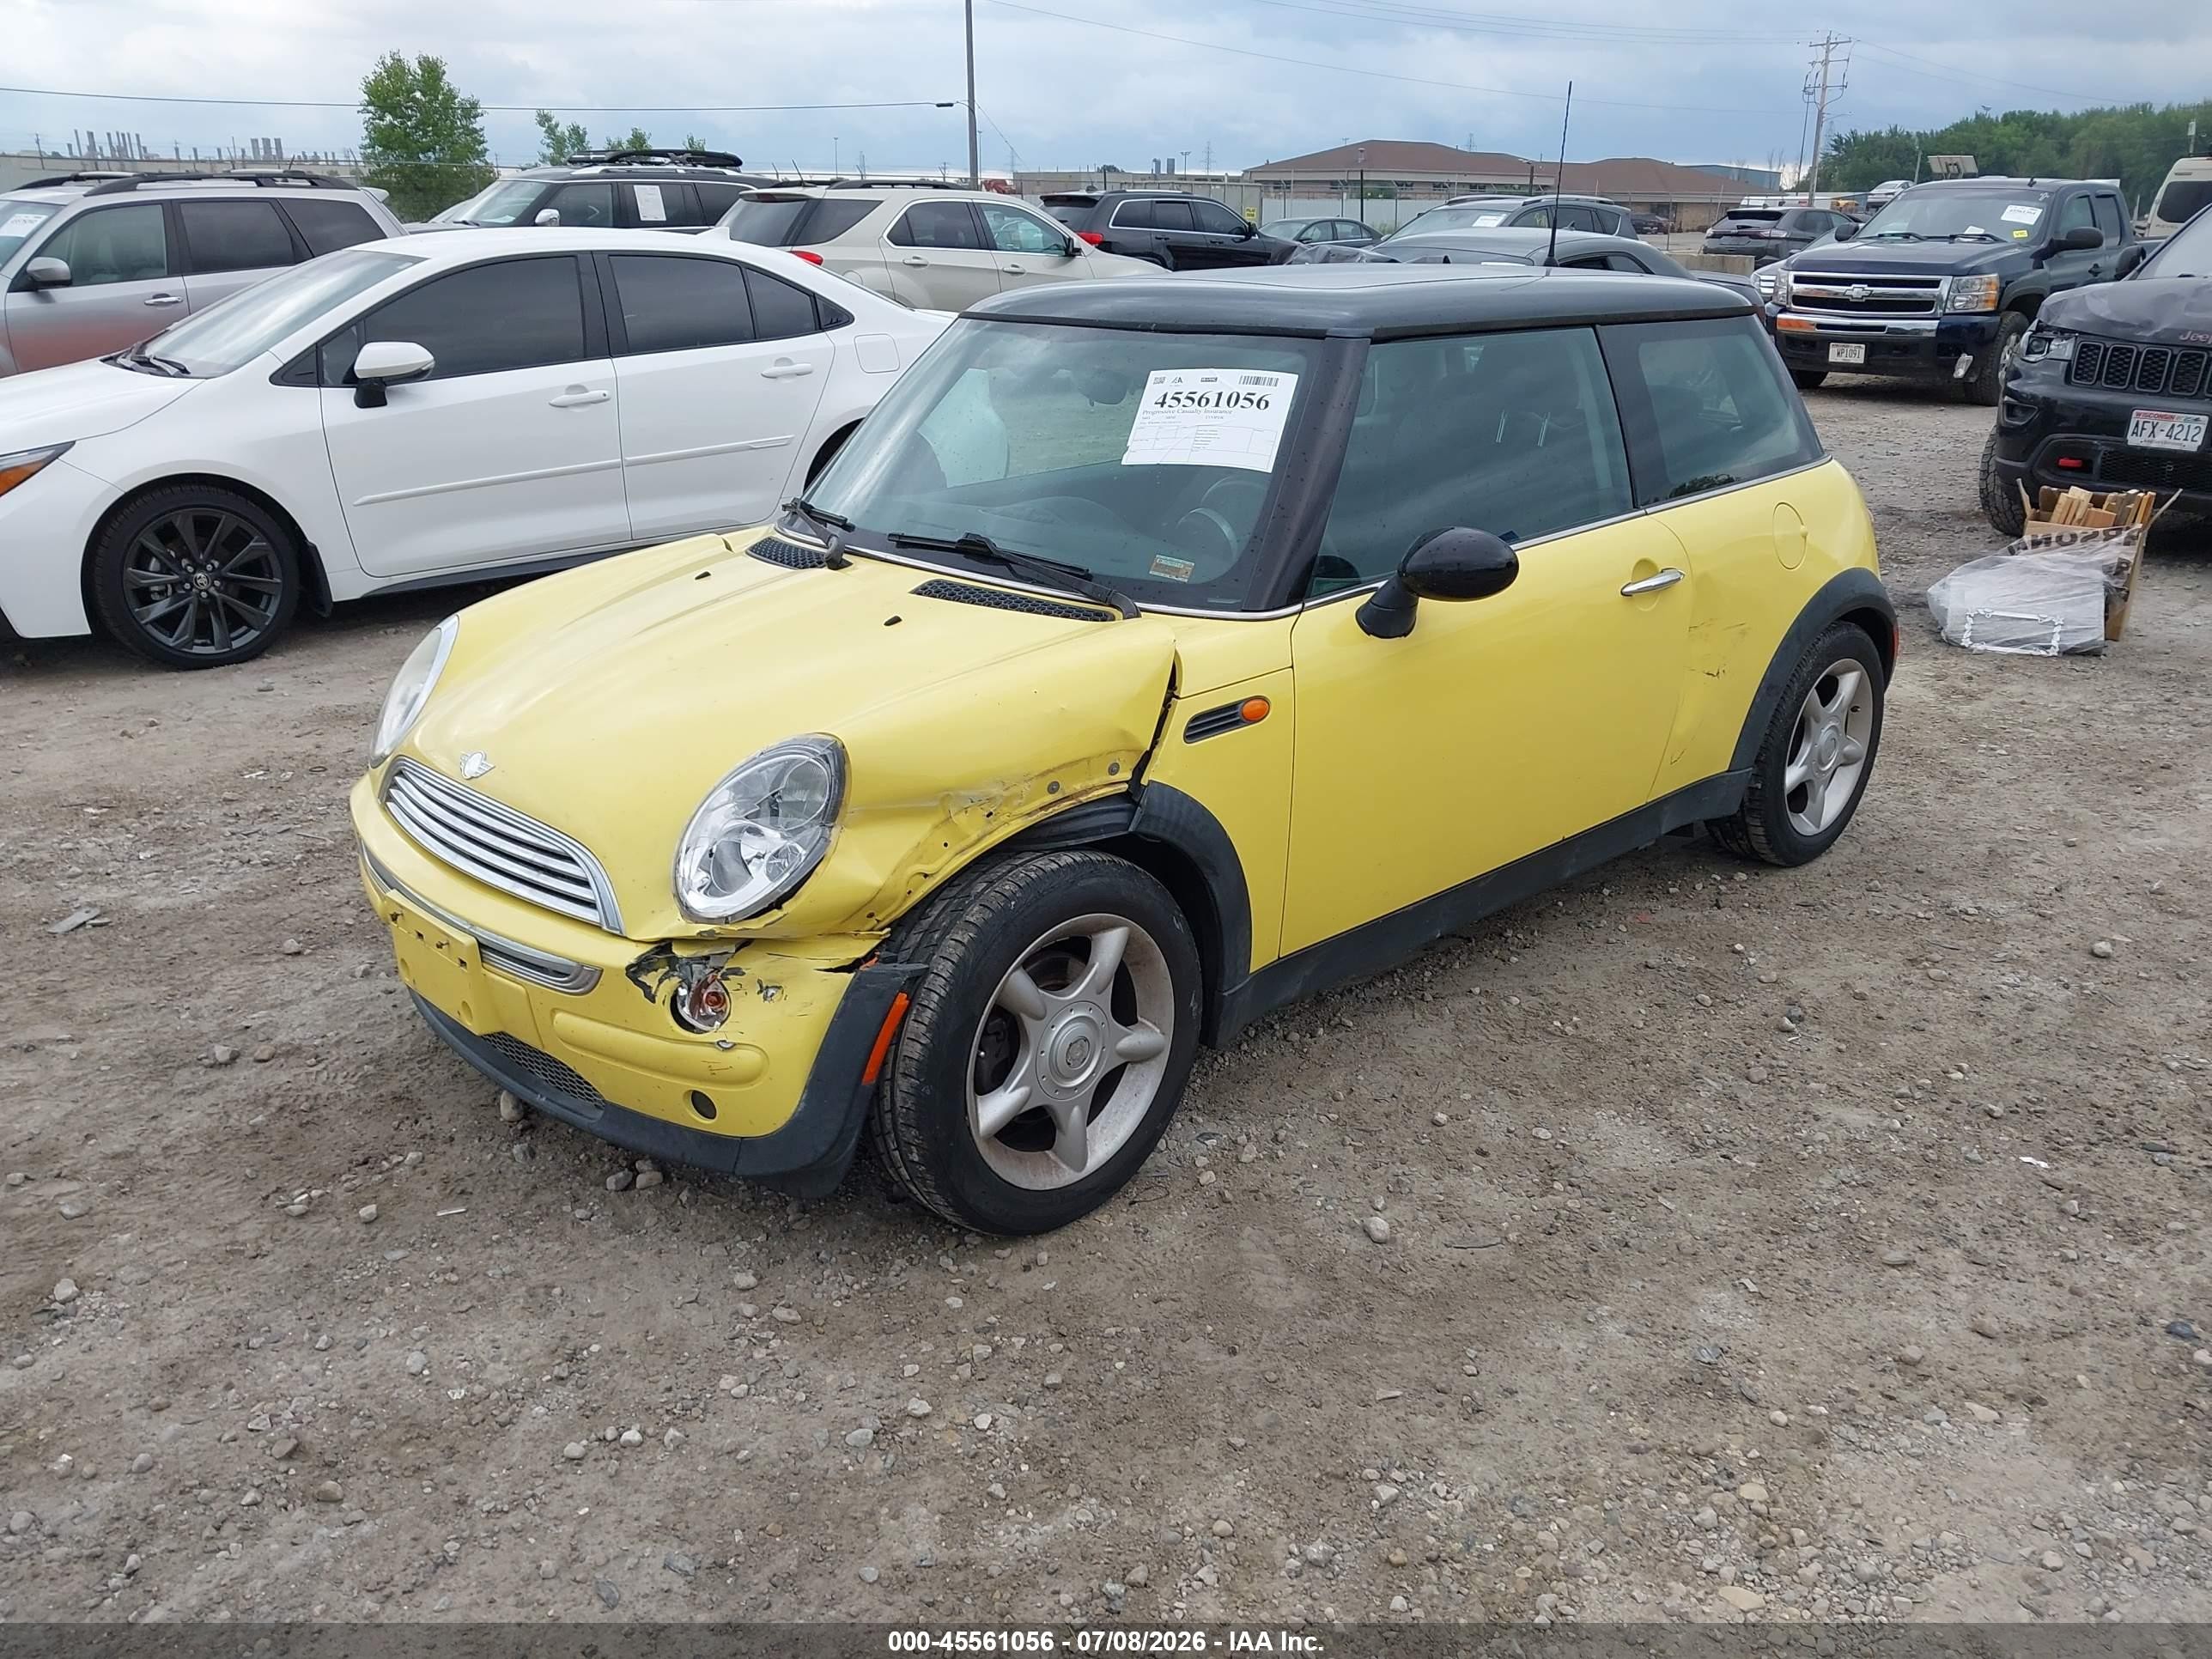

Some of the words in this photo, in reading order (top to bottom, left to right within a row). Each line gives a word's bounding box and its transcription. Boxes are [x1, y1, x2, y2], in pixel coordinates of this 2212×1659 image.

[2179, 331, 2212, 344] Jee
[1154, 391, 1272, 410] 45561056
[2130, 420, 2202, 442] AFX-4212
